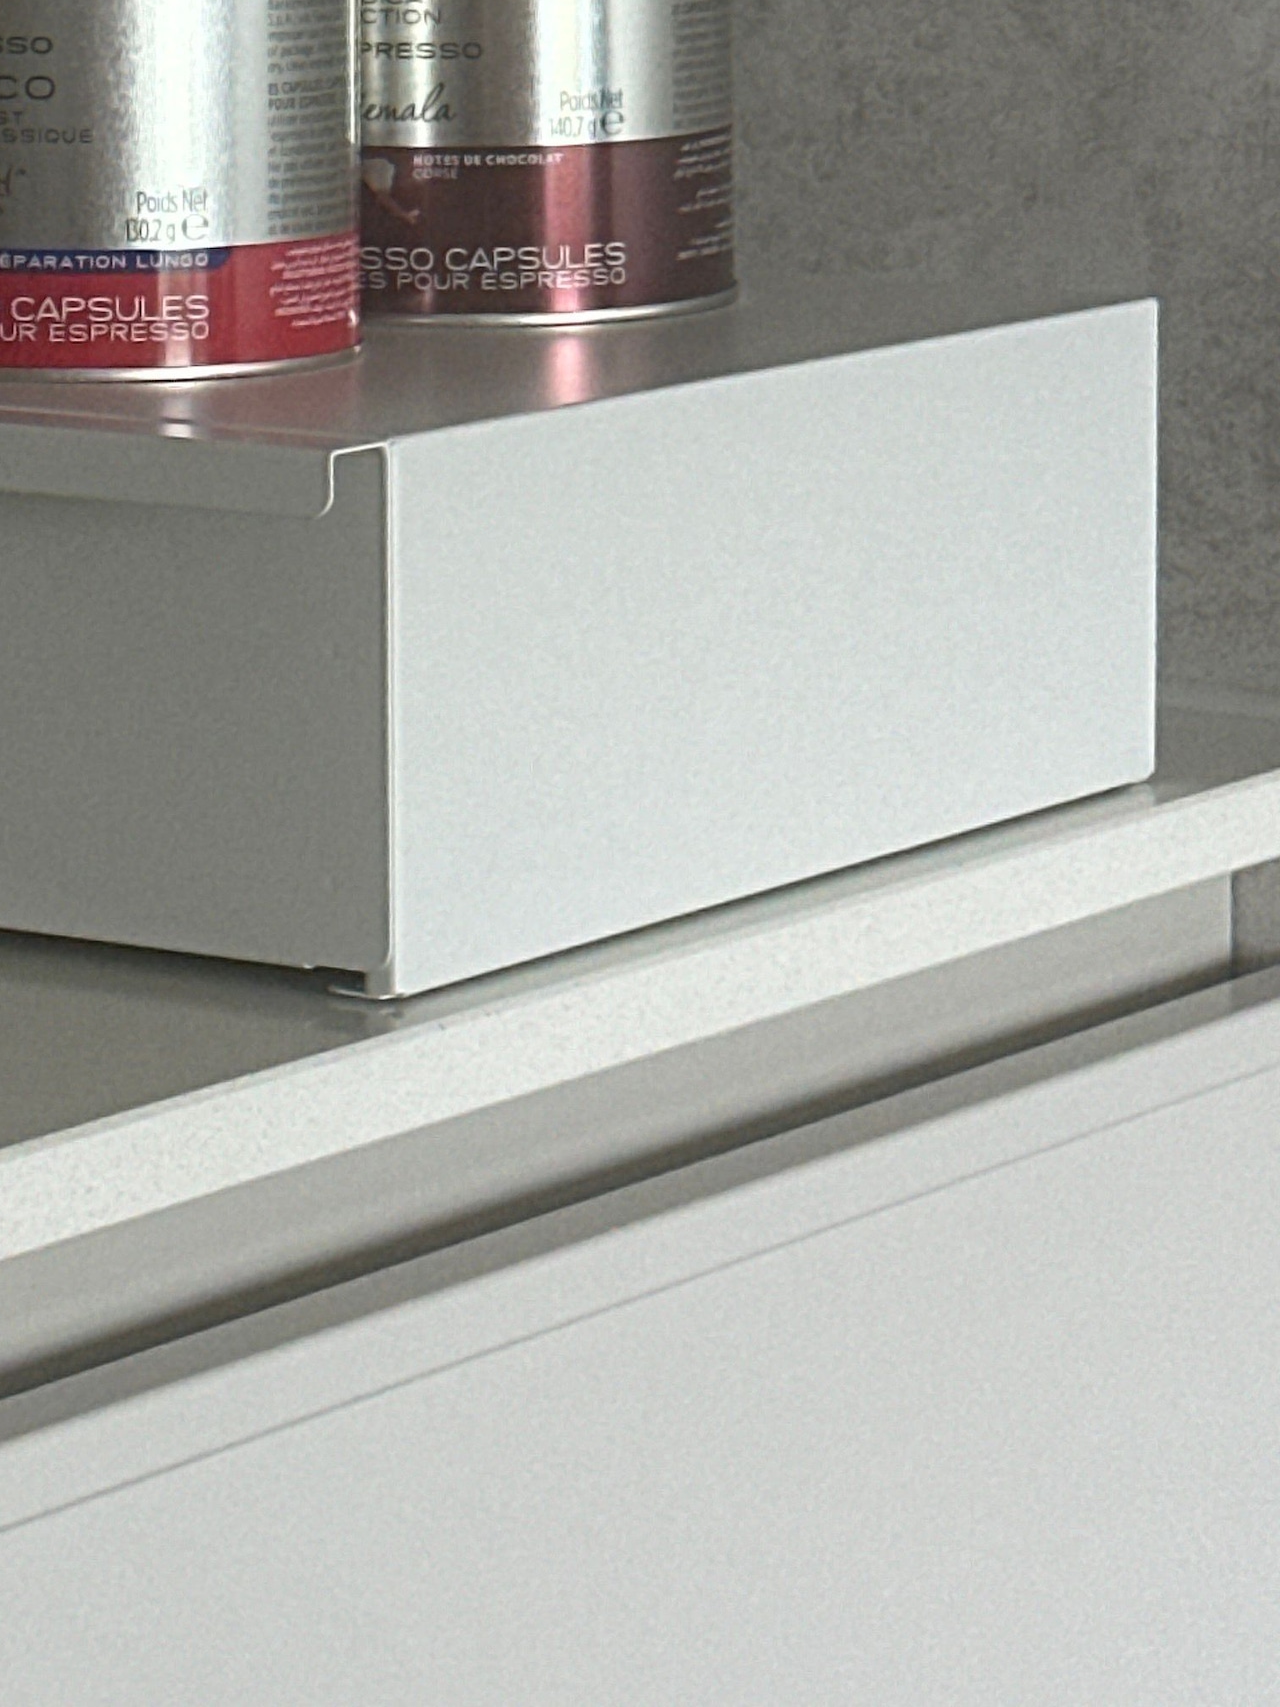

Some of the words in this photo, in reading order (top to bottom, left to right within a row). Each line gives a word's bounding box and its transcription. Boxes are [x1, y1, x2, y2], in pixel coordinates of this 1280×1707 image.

[360, 8, 442, 26] CTION
[361, 81, 456, 123] emala
[136, 190, 178, 214] Poids
[135, 251, 210, 270] LUNGO
[360, 246, 434, 271] SSO
[444, 241, 627, 271] CAPSULES
[396, 271, 470, 290] POUR
[480, 266, 627, 291] ESPRESSO
[10, 294, 211, 323] CAPSULES
[48, 320, 211, 343] ESPRESSO
